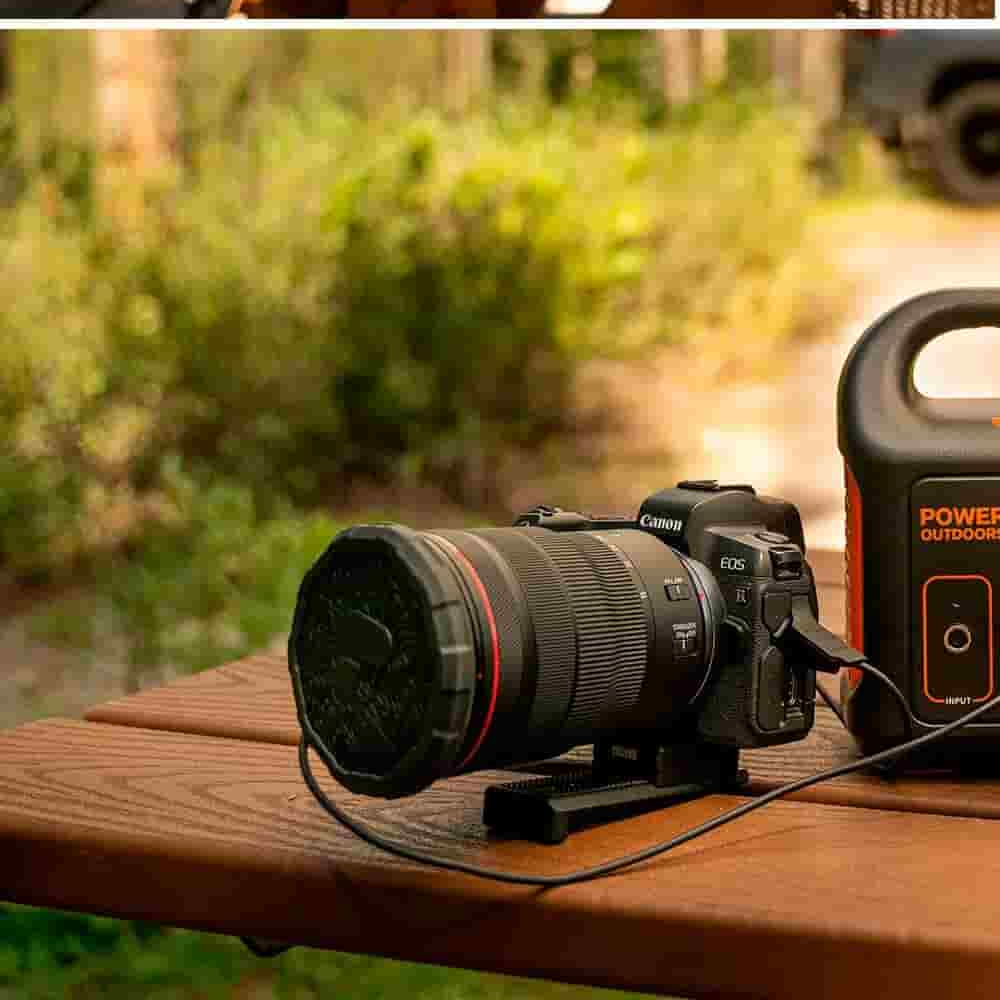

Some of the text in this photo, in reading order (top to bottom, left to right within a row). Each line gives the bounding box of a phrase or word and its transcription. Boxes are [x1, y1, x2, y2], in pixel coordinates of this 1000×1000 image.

[640, 514, 683, 532] Canon
[720, 557, 745, 570] EOS
[945, 695, 971, 705] INPUT
